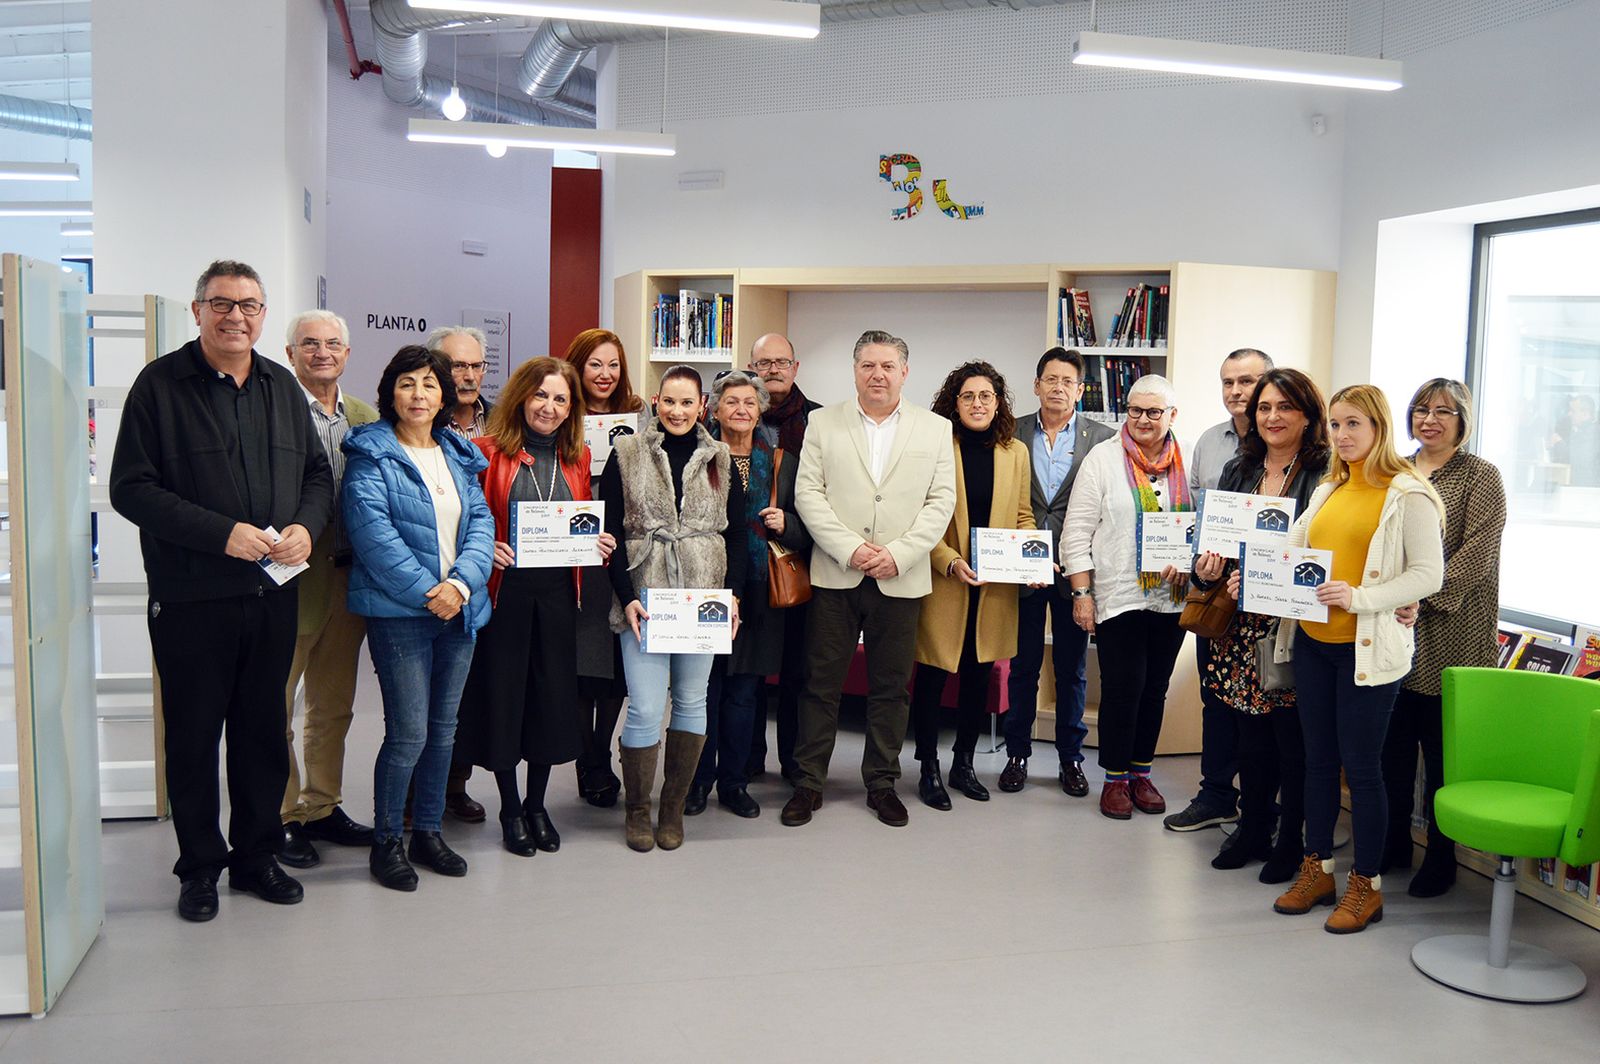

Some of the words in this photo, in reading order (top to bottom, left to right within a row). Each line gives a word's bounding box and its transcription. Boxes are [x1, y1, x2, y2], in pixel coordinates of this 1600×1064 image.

[367, 314, 416, 332] PLANTA
[418, 318, 426, 332] 0
[1207, 514, 1234, 524] DIPLOMA
[1248, 570, 1273, 580] DIPLOMA
